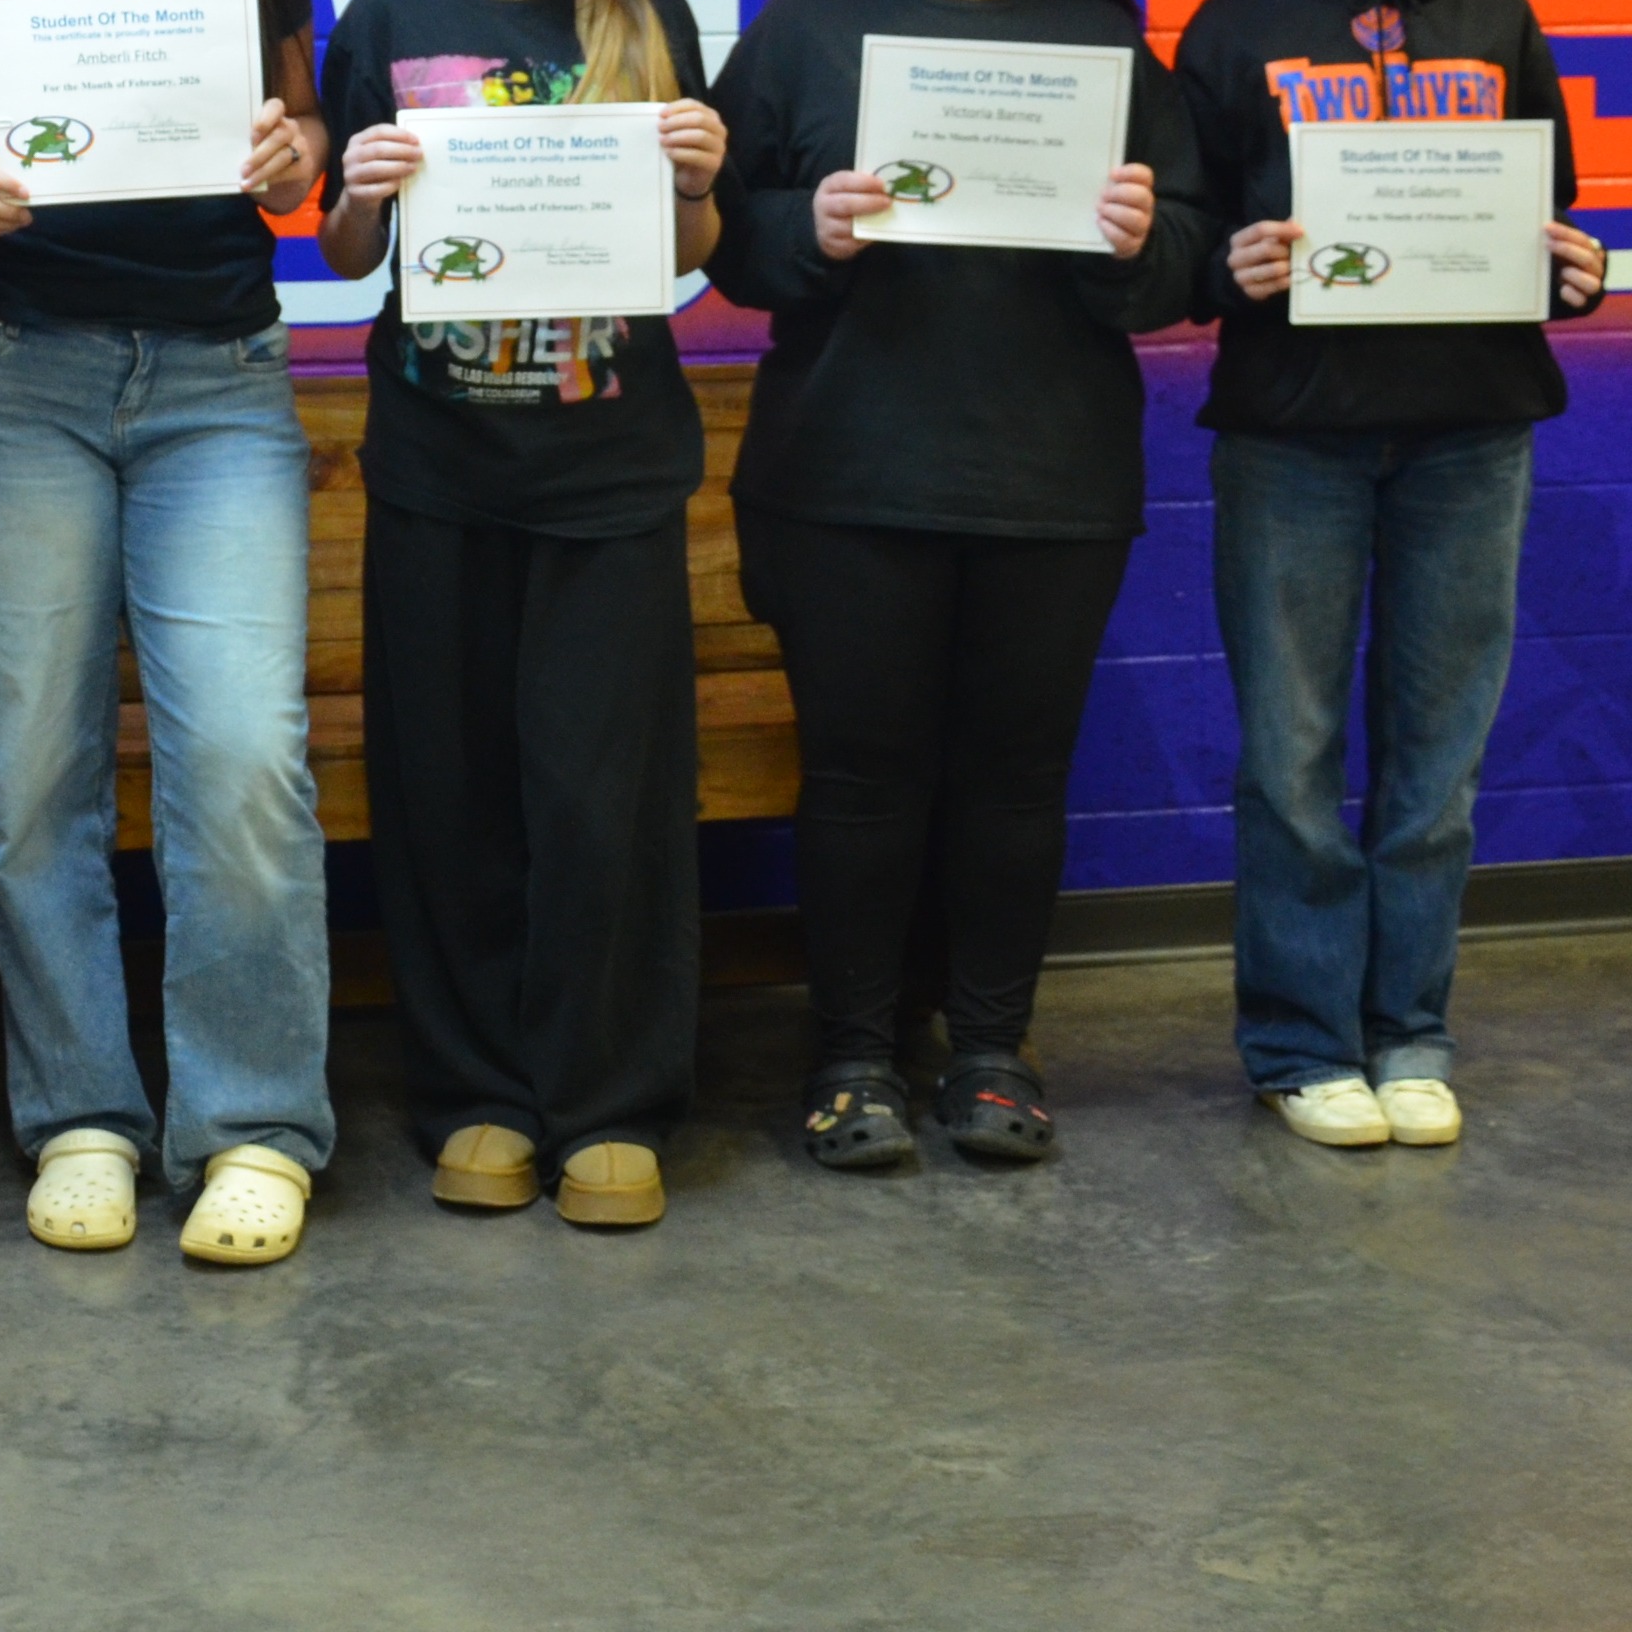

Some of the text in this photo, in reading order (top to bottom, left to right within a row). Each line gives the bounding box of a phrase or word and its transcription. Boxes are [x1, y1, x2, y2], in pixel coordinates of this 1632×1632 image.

[31, 9, 204, 29] Student Of The Month
[77, 49, 167, 65] Amberli Fitch
[43, 84, 59, 92] For
[63, 83, 78, 91] the
[82, 81, 113, 90] Month
[179, 76, 201, 85] 2026
[910, 66, 1077, 87] Student Of The Month
[1278, 71, 1370, 121] TWO
[448, 136, 618, 151] Student Of The Month
[1340, 149, 1503, 162] Student Of The Month
[491, 174, 581, 188] Hannah Reed
